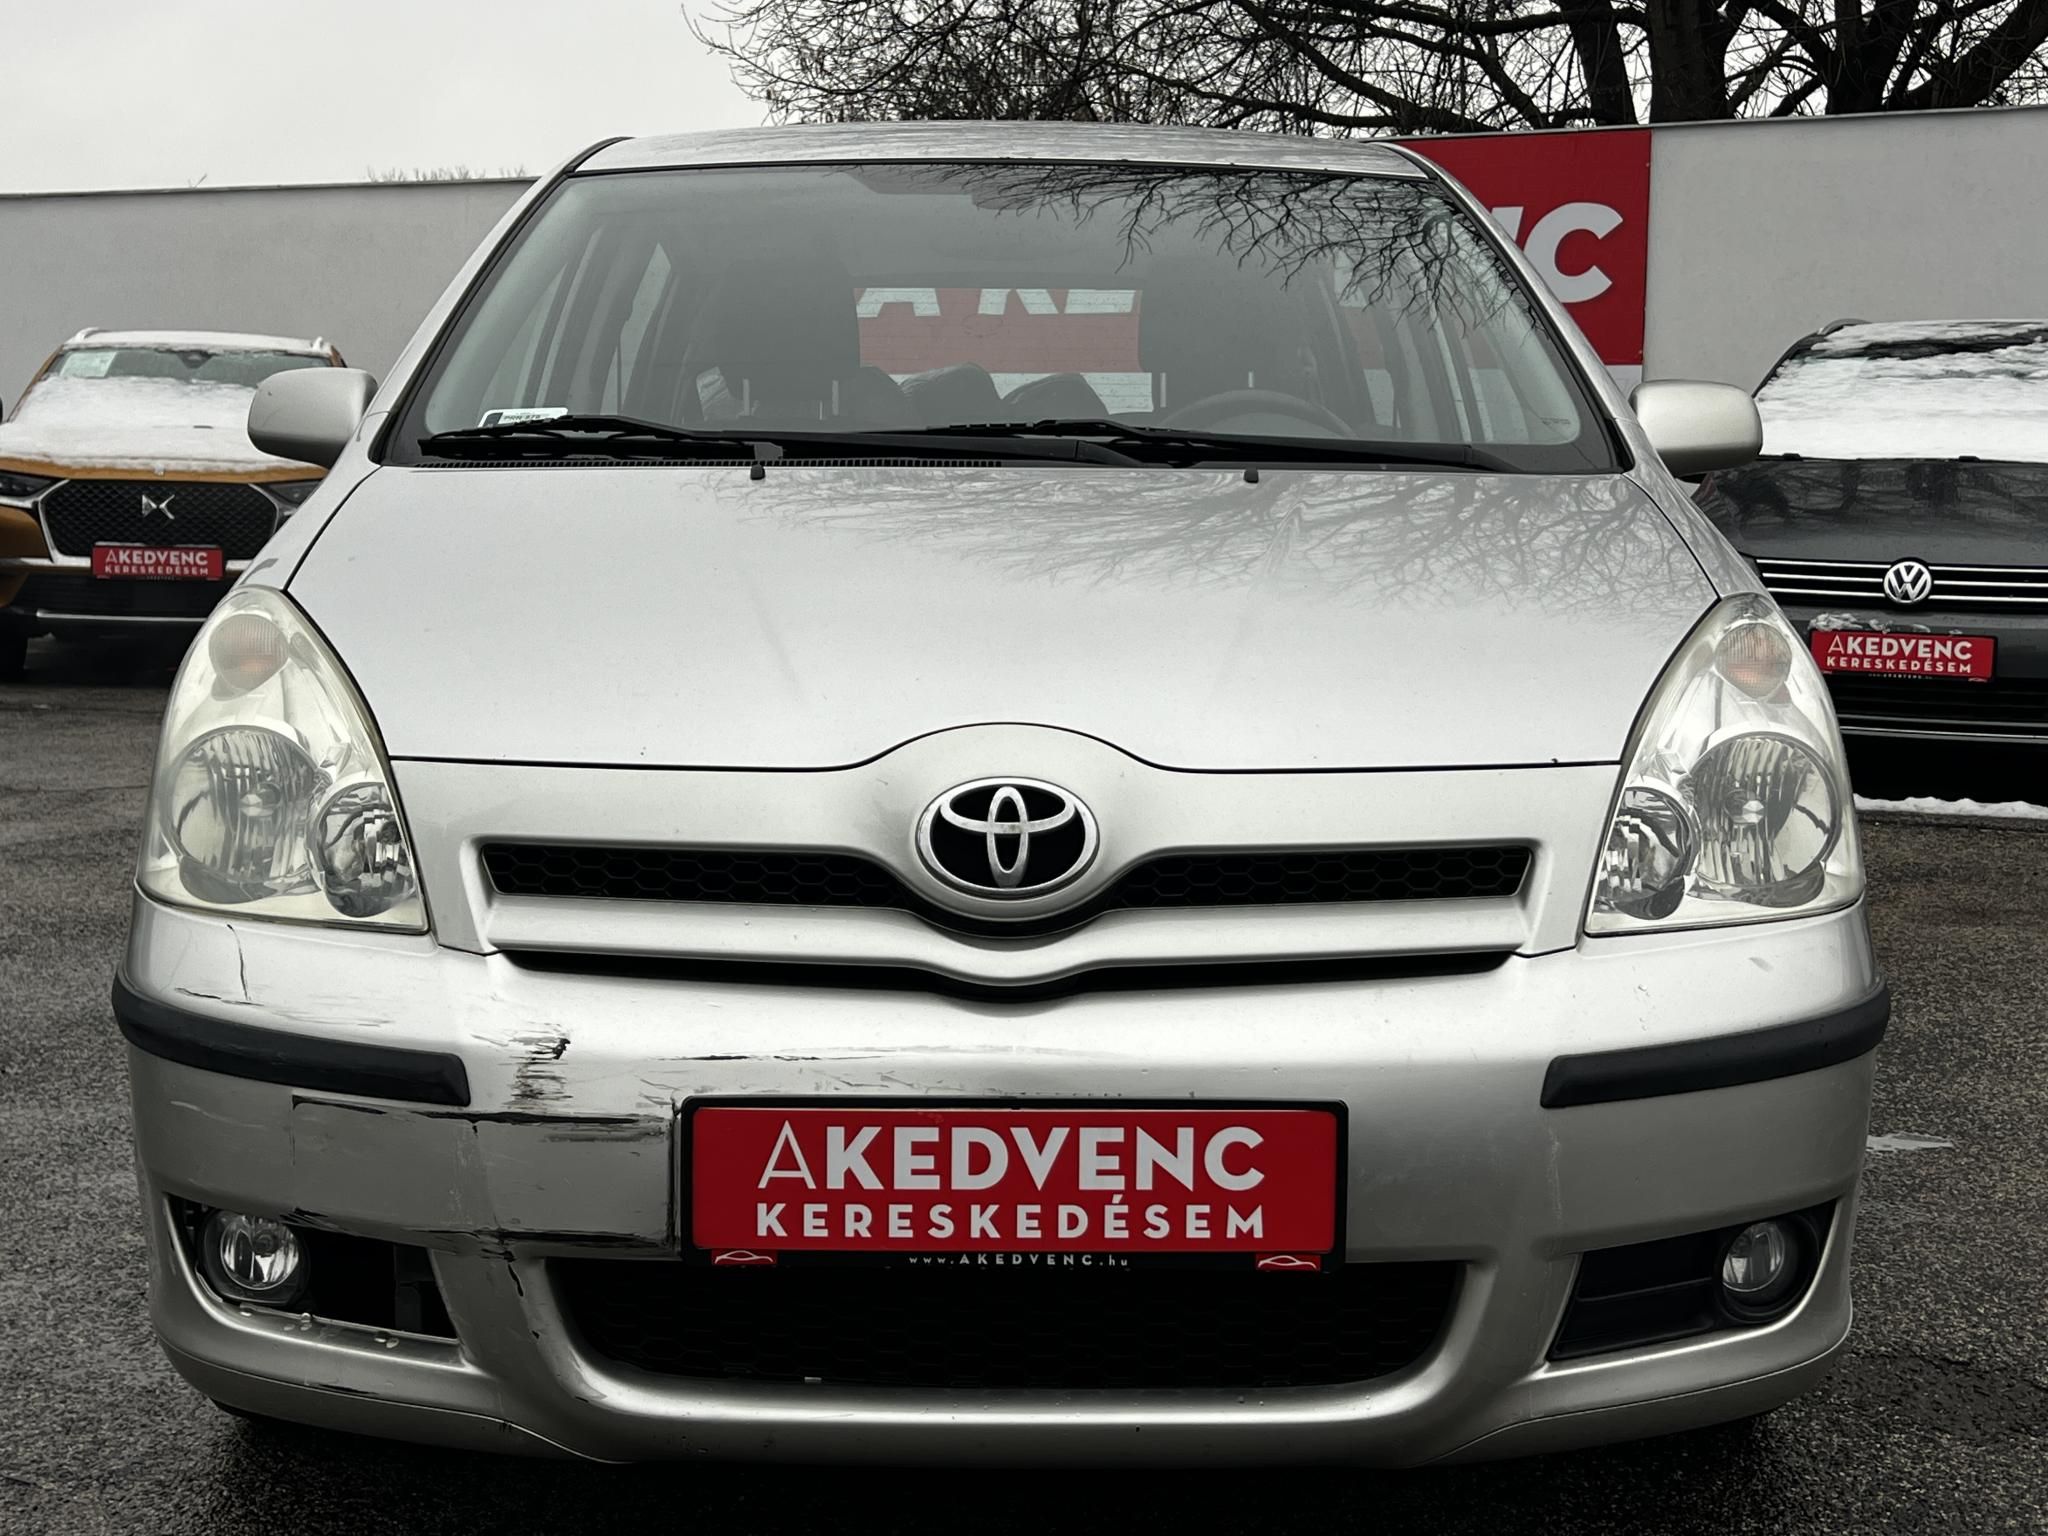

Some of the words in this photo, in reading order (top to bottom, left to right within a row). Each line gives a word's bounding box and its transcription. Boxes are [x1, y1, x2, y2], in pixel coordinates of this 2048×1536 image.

[1490, 202, 1624, 304] C
[105, 549, 208, 566] AKEDVENC
[1827, 634, 1973, 660] AKEDVENC
[1826, 656, 1972, 674] KERESKEDÉSEM
[757, 1119, 1265, 1193] AKEDVENC
[756, 1195, 1264, 1239] KERESKEDÉSEM
[908, 1253, 1129, 1267] www.AKEDVENC.hu
